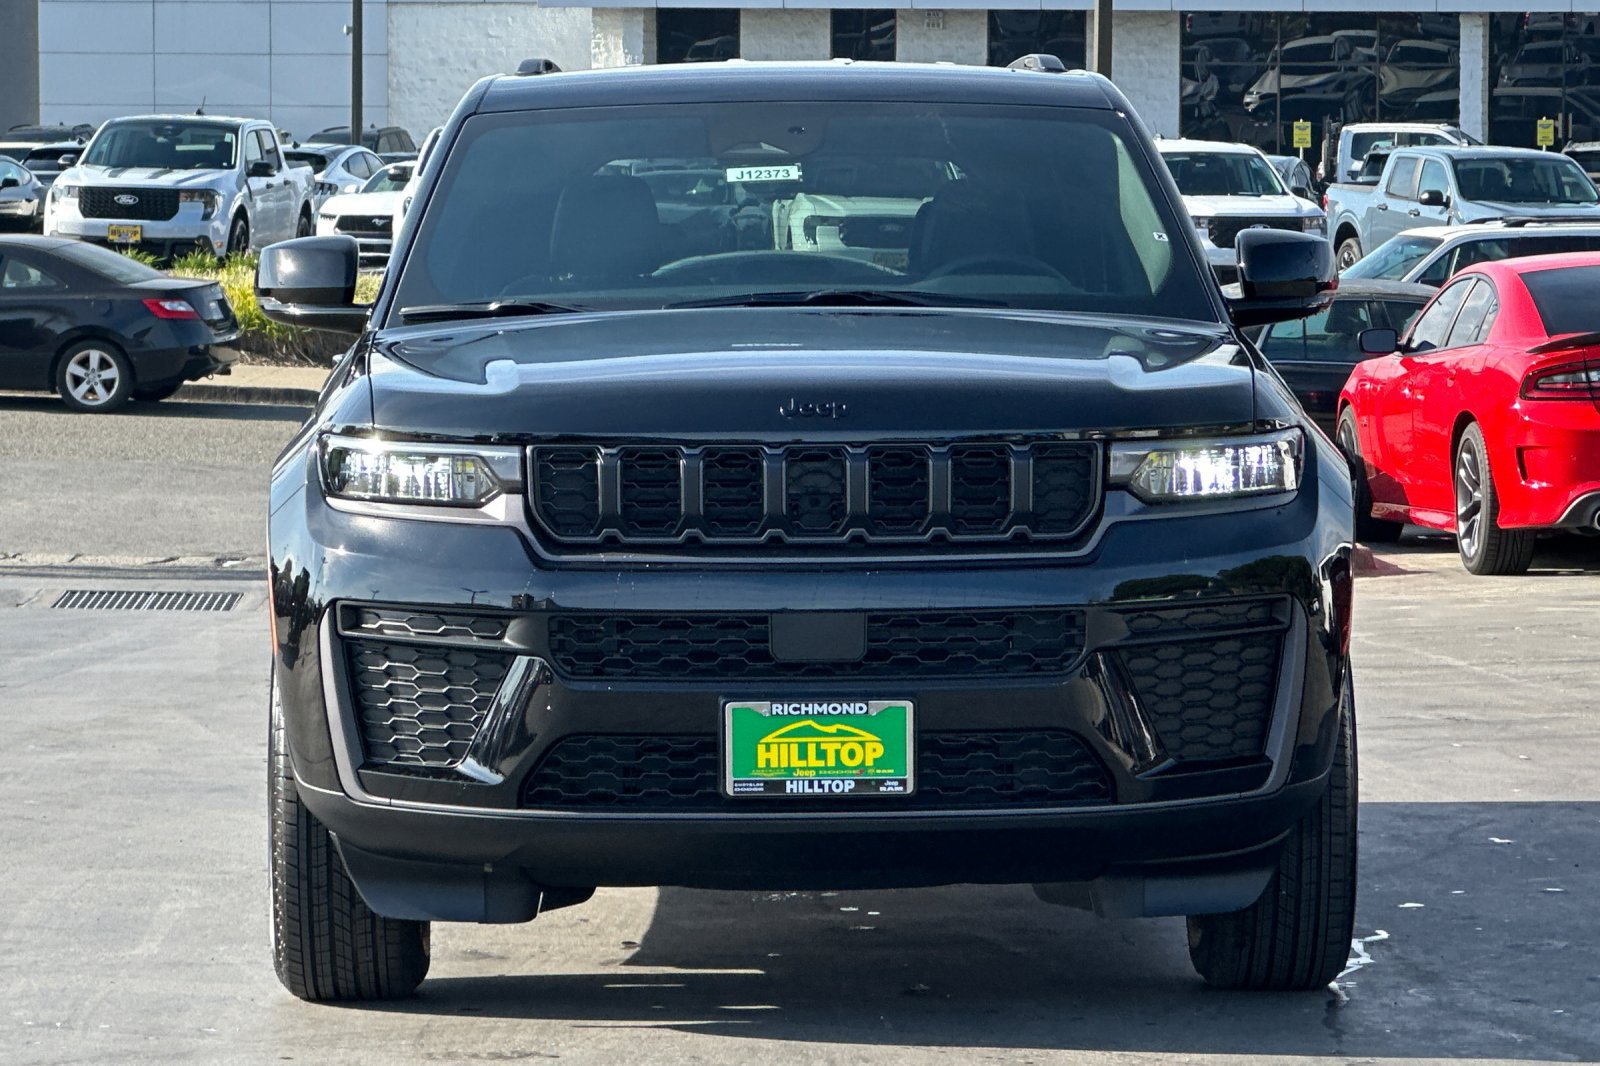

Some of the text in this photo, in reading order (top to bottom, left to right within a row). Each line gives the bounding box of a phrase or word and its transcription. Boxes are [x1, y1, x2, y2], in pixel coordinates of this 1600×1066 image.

[736, 169, 791, 180] J12373
[779, 397, 849, 421] Jeep
[771, 703, 868, 716] RICHMOND
[757, 741, 885, 769] HILLTOP
[792, 768, 816, 778] Jeep
[785, 779, 856, 794] HILLTOP
[884, 779, 899, 787] Jeep
